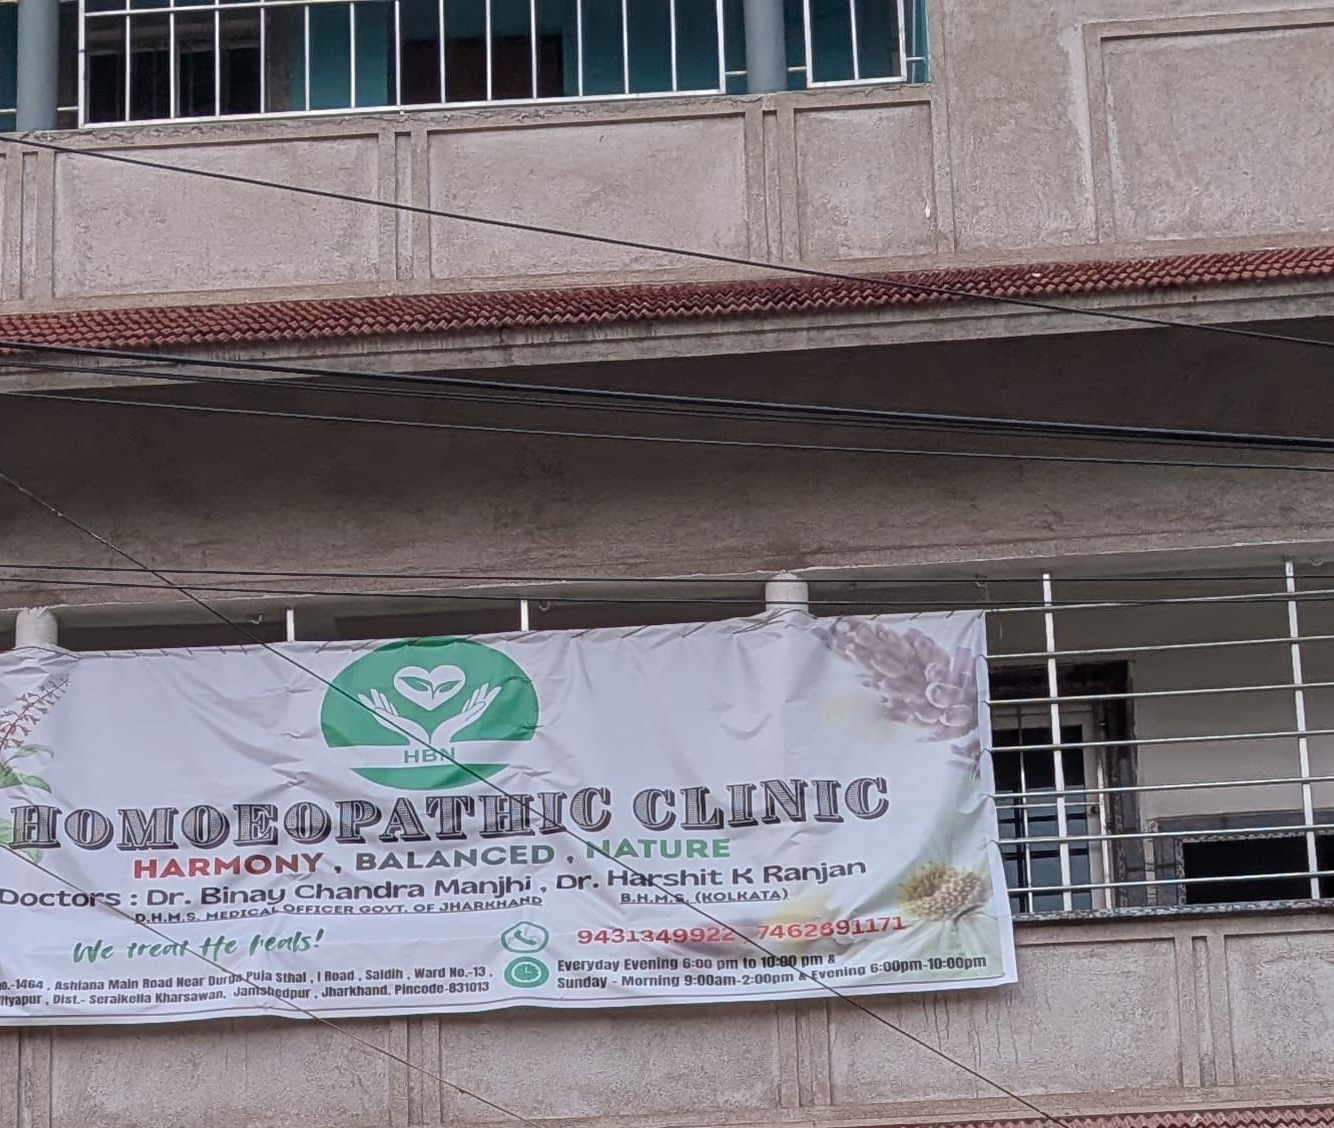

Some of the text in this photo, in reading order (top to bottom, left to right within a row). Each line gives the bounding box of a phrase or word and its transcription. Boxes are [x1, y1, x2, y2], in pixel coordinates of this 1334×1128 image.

[403, 746, 455, 764] HBN
[10, 777, 889, 850] HOMOEOPATHIC CLINIC
[134, 852, 324, 879] HARMONY
[355, 845, 555, 871] BALANCED
[586, 838, 731, 860] NATURE
[147, 889, 192, 906] Dr.
[201, 886, 285, 906] Binay
[295, 880, 424, 901] Chandra
[434, 875, 531, 898] Manjhi
[556, 873, 599, 890] Dr.
[608, 867, 723, 888] Harshit
[732, 865, 754, 883] K
[763, 861, 867, 885] Ranjan
[695, 888, 788, 903] (KOLKATA)
[135, 895, 543, 924] D.H.M.S. MEDICAL OFFICER GOVT. OF JHARKHAND
[577, 928, 736, 944] 9431349922
[72, 939, 114, 963] We
[127, 940, 189, 960] treat
[557, 959, 619, 972] Everyday
[624, 956, 678, 971] Evening
[682, 957, 712, 969] 6:00
[717, 956, 738, 971] pm
[743, 956, 757, 969] to
[801, 954, 823, 968] pm
[54, 980, 104, 991] Ashiana
[108, 979, 139, 990] Main
[142, 977, 173, 989] Road
[176, 976, 205, 988] Near
[275, 972, 307, 983] Sthal
[324, 970, 354, 981] Road
[365, 969, 403, 981] Saldih
[414, 968, 446, 979] Ward
[557, 975, 607, 989] Sunday
[621, 973, 679, 988] Morning
[811, 966, 866, 979] Evening
